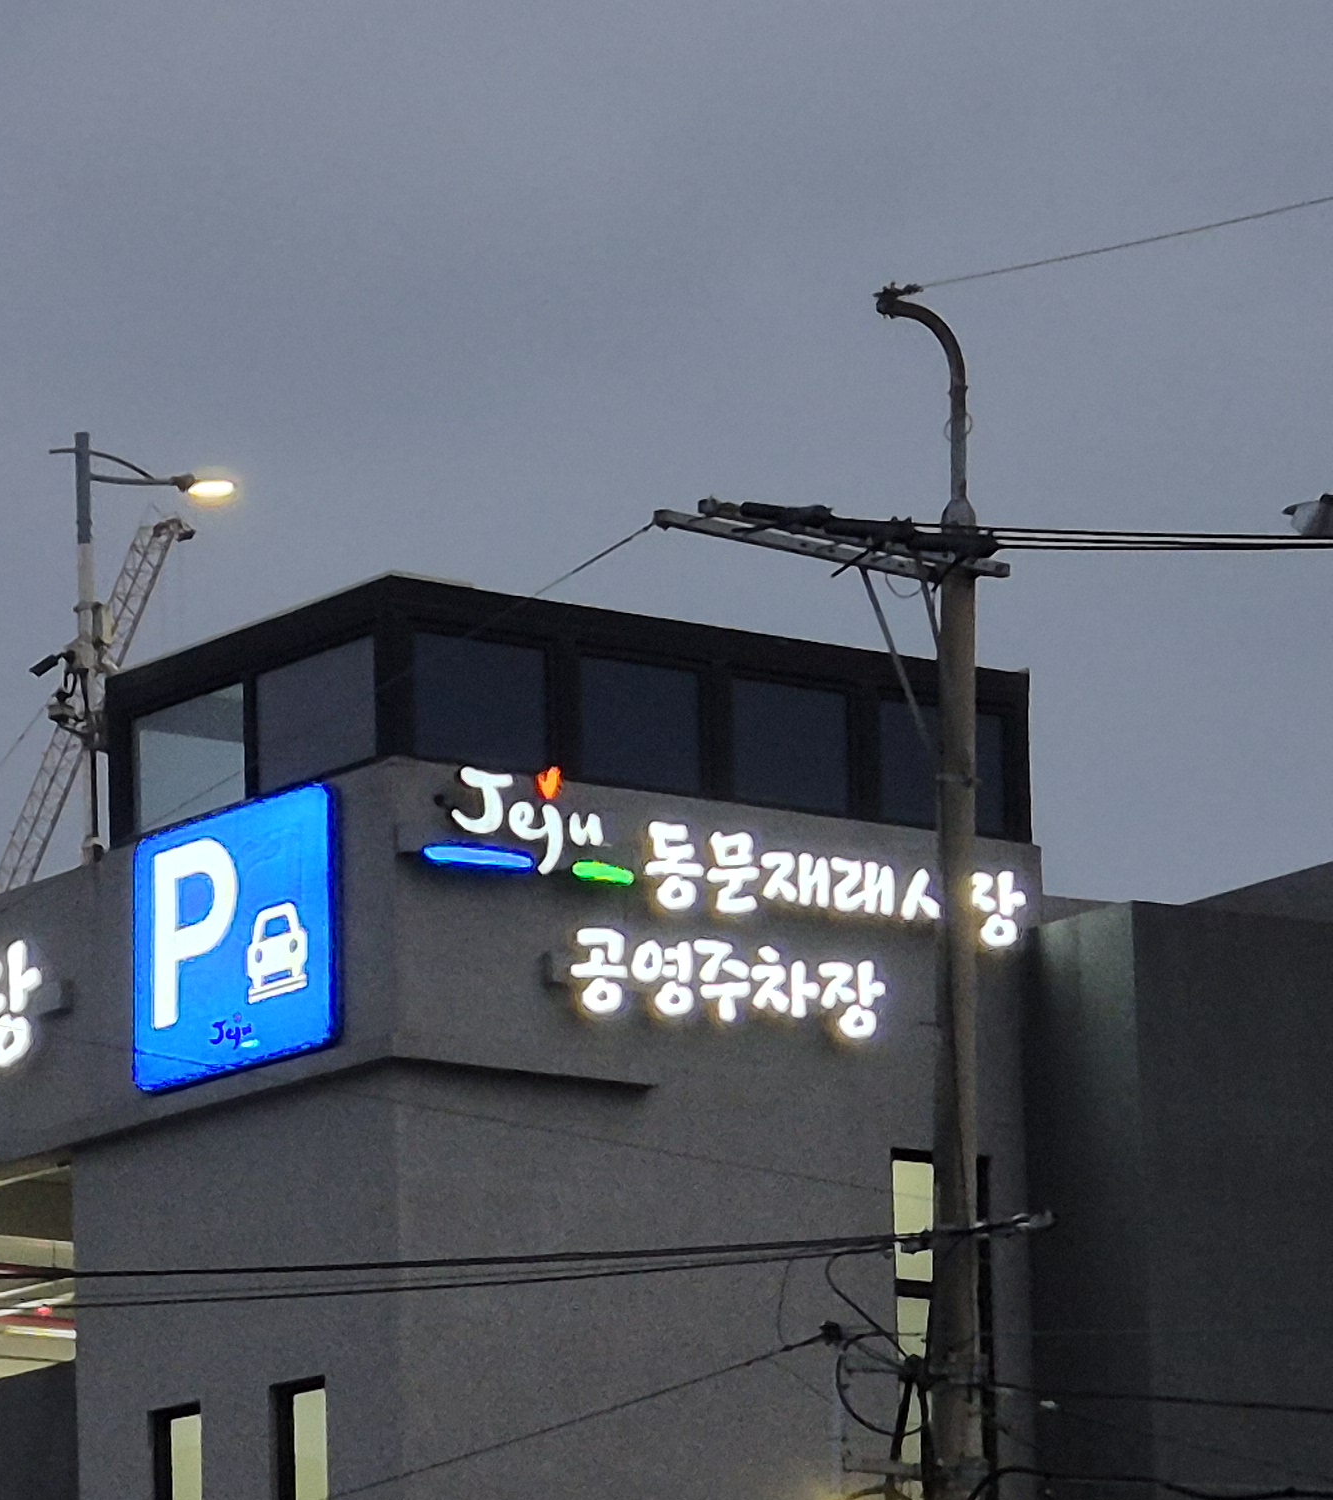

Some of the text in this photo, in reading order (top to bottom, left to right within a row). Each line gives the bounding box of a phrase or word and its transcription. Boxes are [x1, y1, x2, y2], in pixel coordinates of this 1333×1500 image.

[452, 766, 603, 874] Jeju
[151, 837, 238, 1030] P
[569, 926, 887, 1040] 공영주차장
[209, 1012, 252, 1050] Jeju
